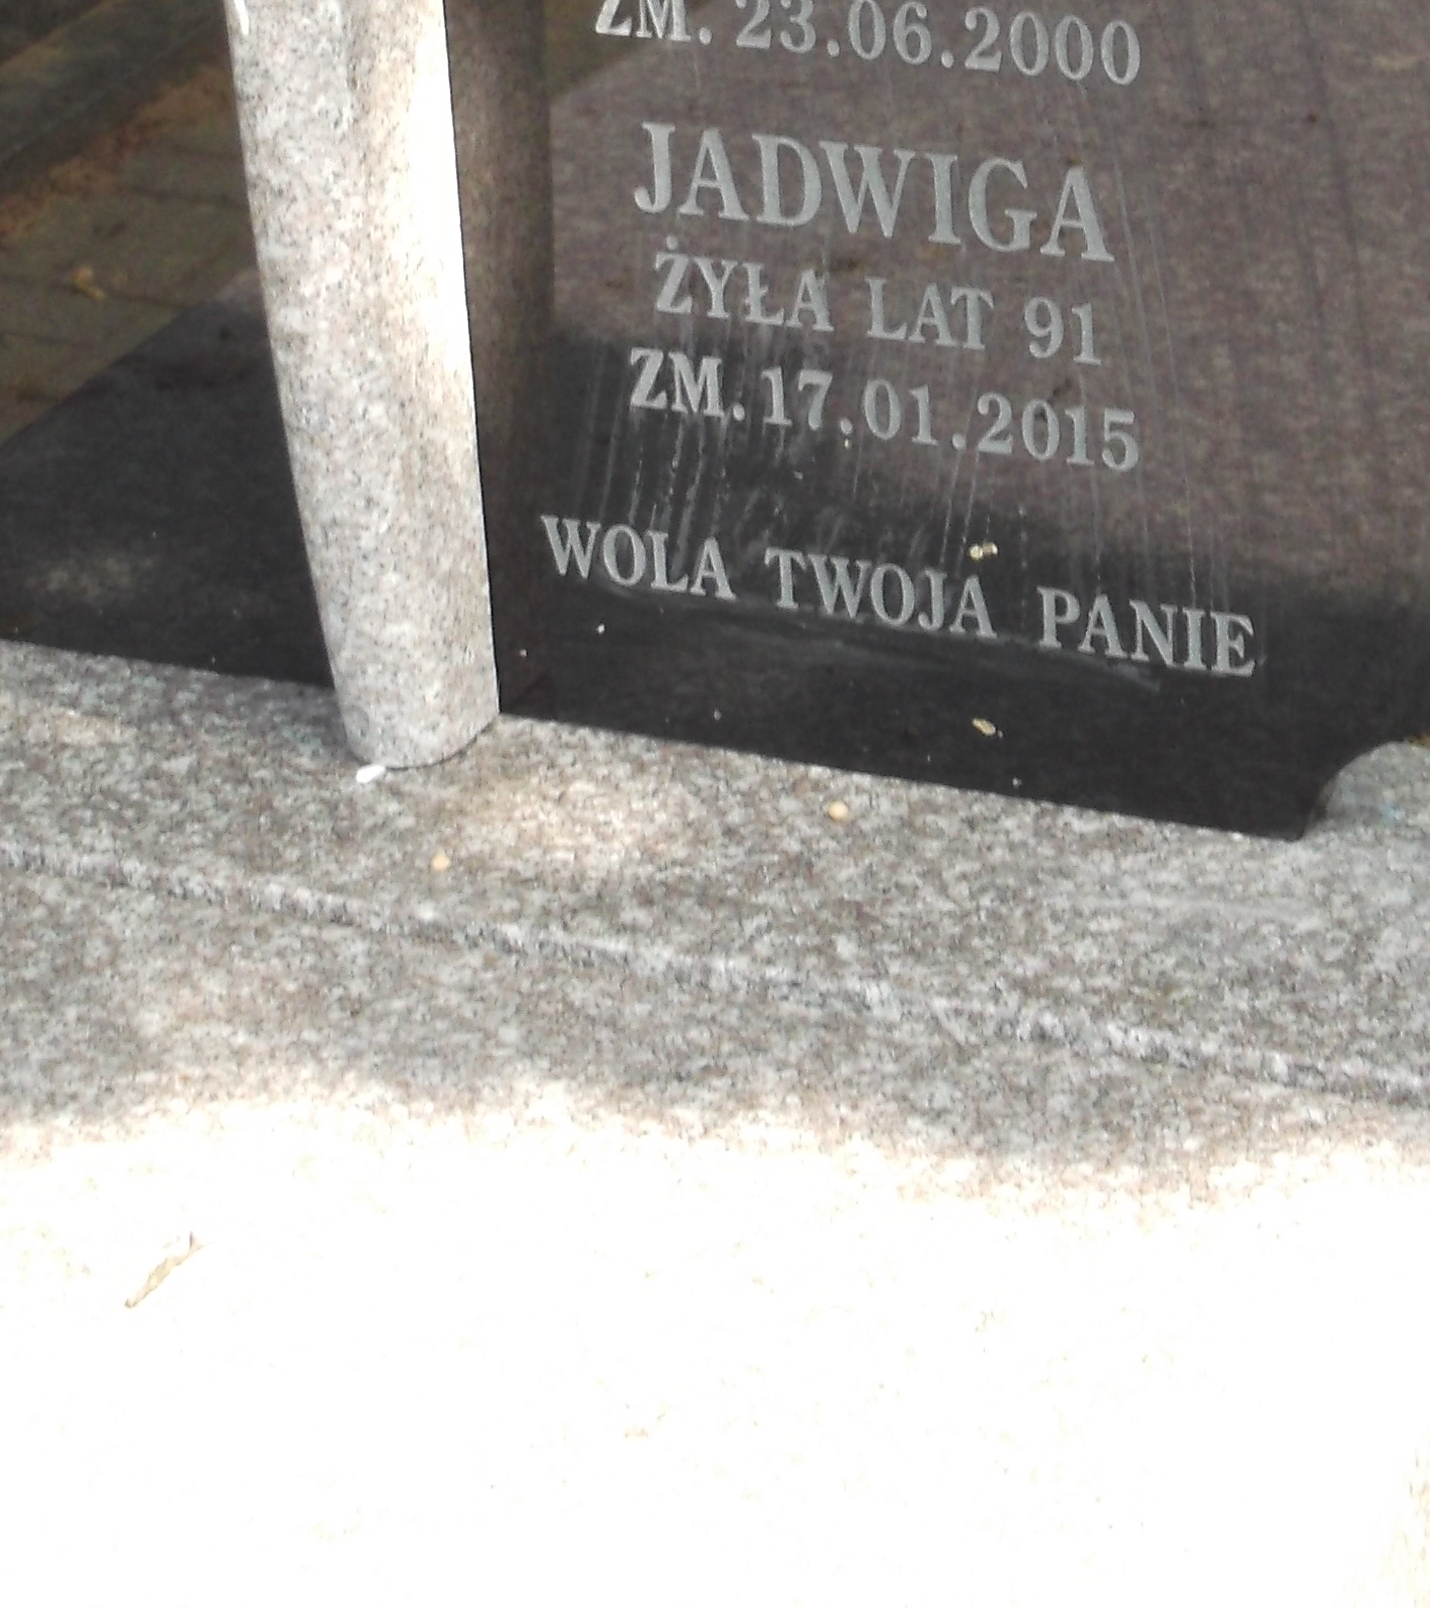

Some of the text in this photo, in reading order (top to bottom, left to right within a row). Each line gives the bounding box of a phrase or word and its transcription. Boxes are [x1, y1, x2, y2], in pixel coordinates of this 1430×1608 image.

[634, 122, 1115, 262] JADWIGA
[654, 235, 1102, 366] ŻYŁA LAT 91
[629, 347, 1140, 472] ZM. 17.01.2015
[541, 513, 1257, 678] WOLA TWOJA PANIE
